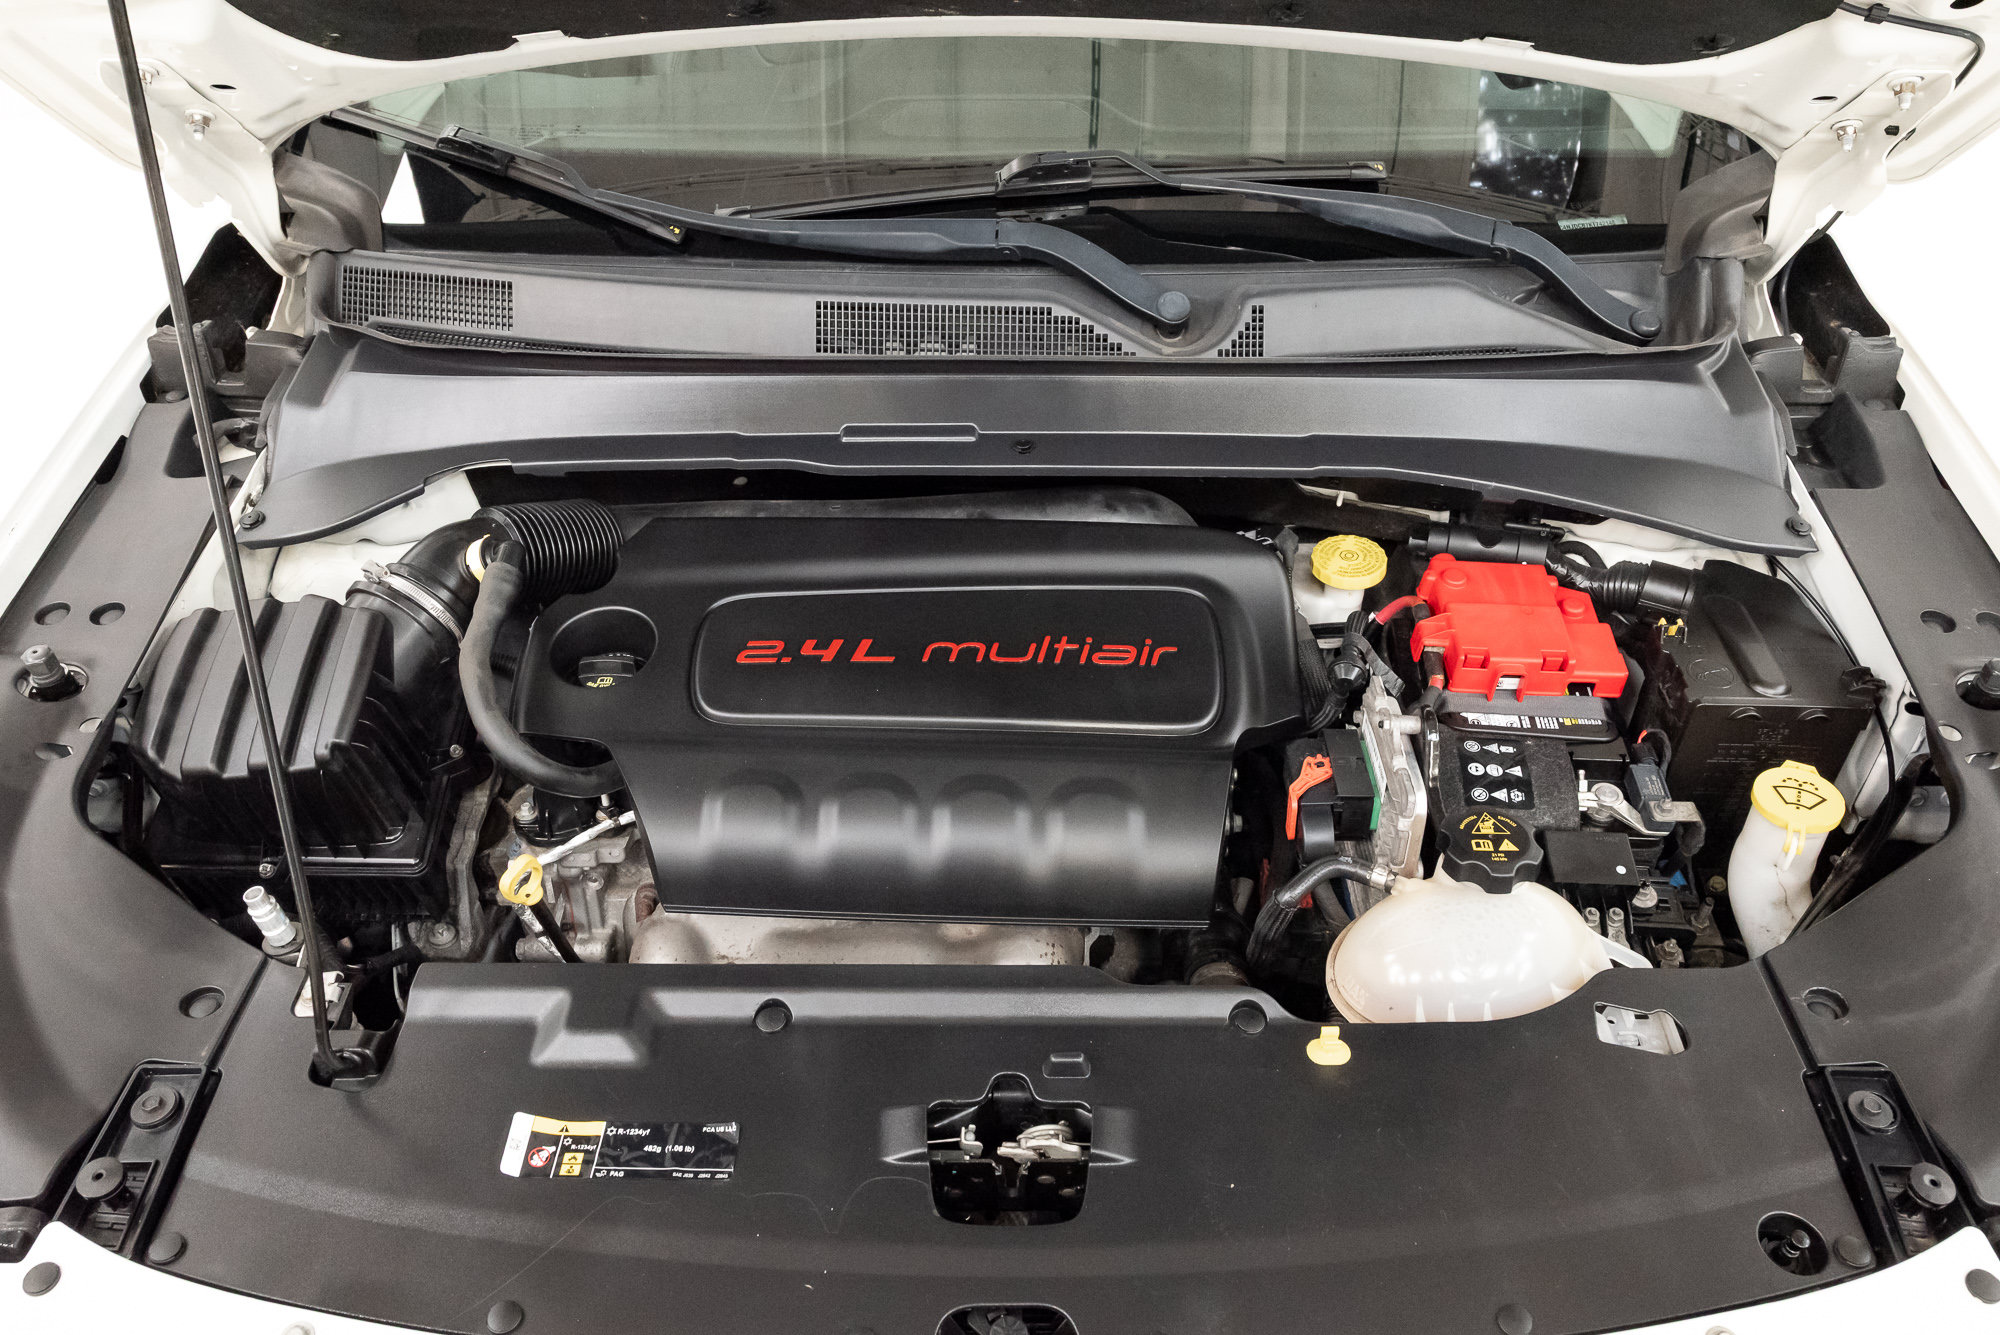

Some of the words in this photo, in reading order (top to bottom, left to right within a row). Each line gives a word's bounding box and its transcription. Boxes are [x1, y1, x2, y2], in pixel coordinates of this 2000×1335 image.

[735, 638, 896, 664] 2.4L
[921, 635, 1178, 667] multiair
[617, 1128, 650, 1137] R-1234yf
[570, 1143, 598, 1151] R-1234yf
[684, 1145, 695, 1153] lb)
[609, 1170, 625, 1178] PAG
